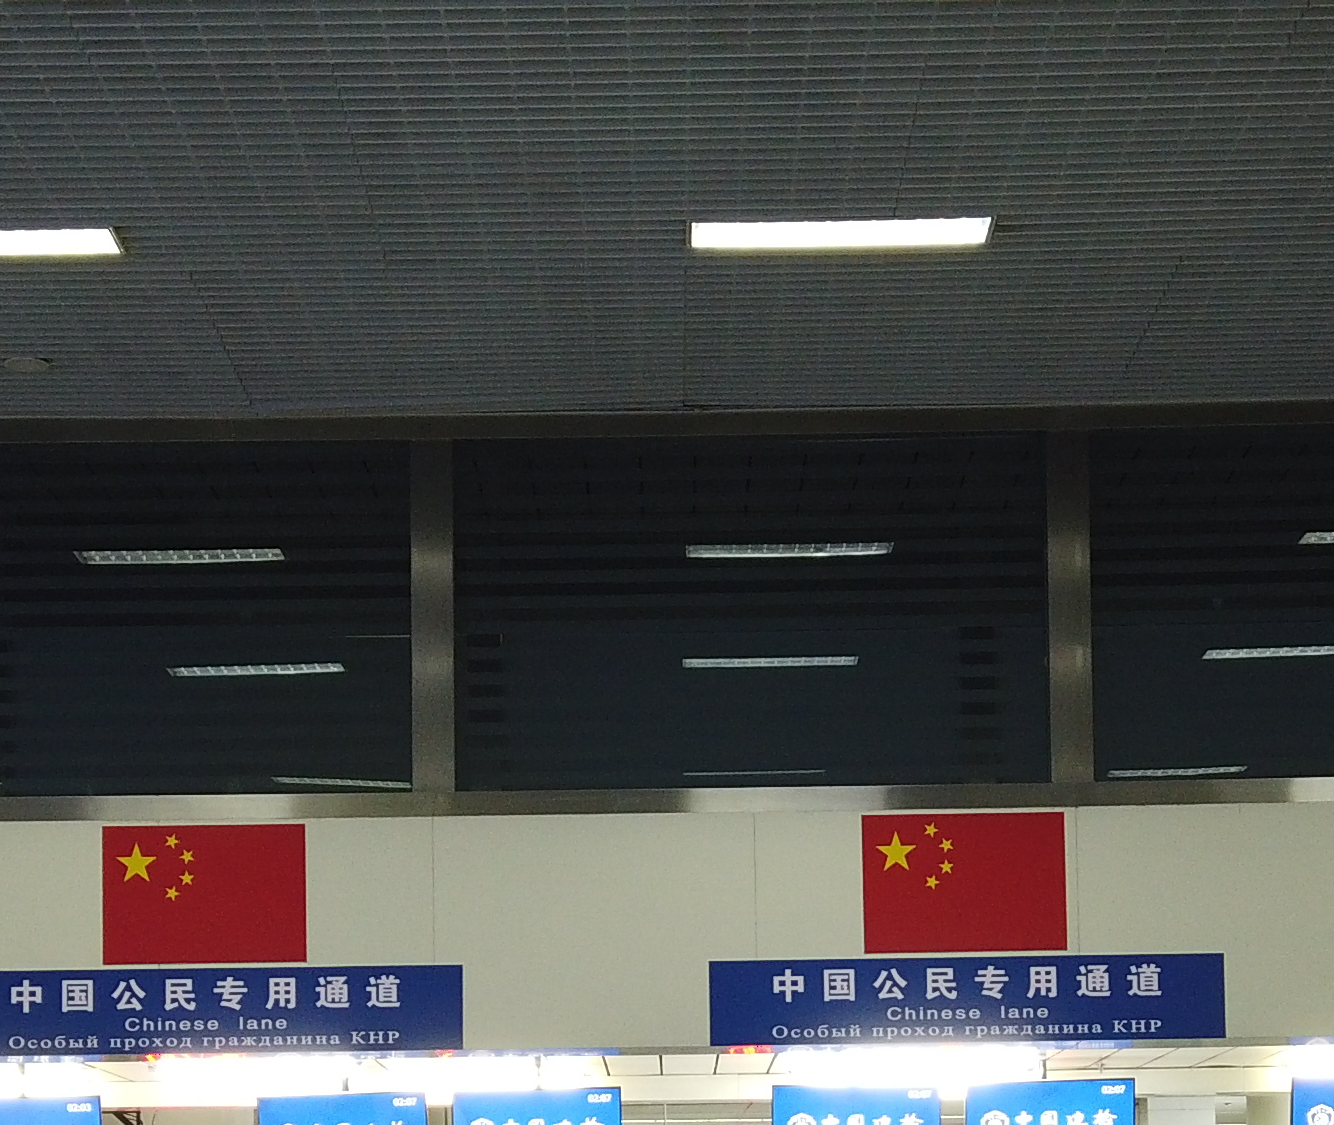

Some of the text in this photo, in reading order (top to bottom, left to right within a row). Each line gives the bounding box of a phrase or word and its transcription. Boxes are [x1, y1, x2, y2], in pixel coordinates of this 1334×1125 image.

[771, 963, 1163, 1003] 中国公民专用通道
[10, 975, 401, 1014] 中国公民专用通道
[885, 1004, 1049, 1021] Chinese lane
[124, 1016, 288, 1032] Chinese lane
[771, 1019, 1163, 1041] Особый проход гражданина КНР
[8, 1031, 401, 1052] Особый проход гражданина КНР
